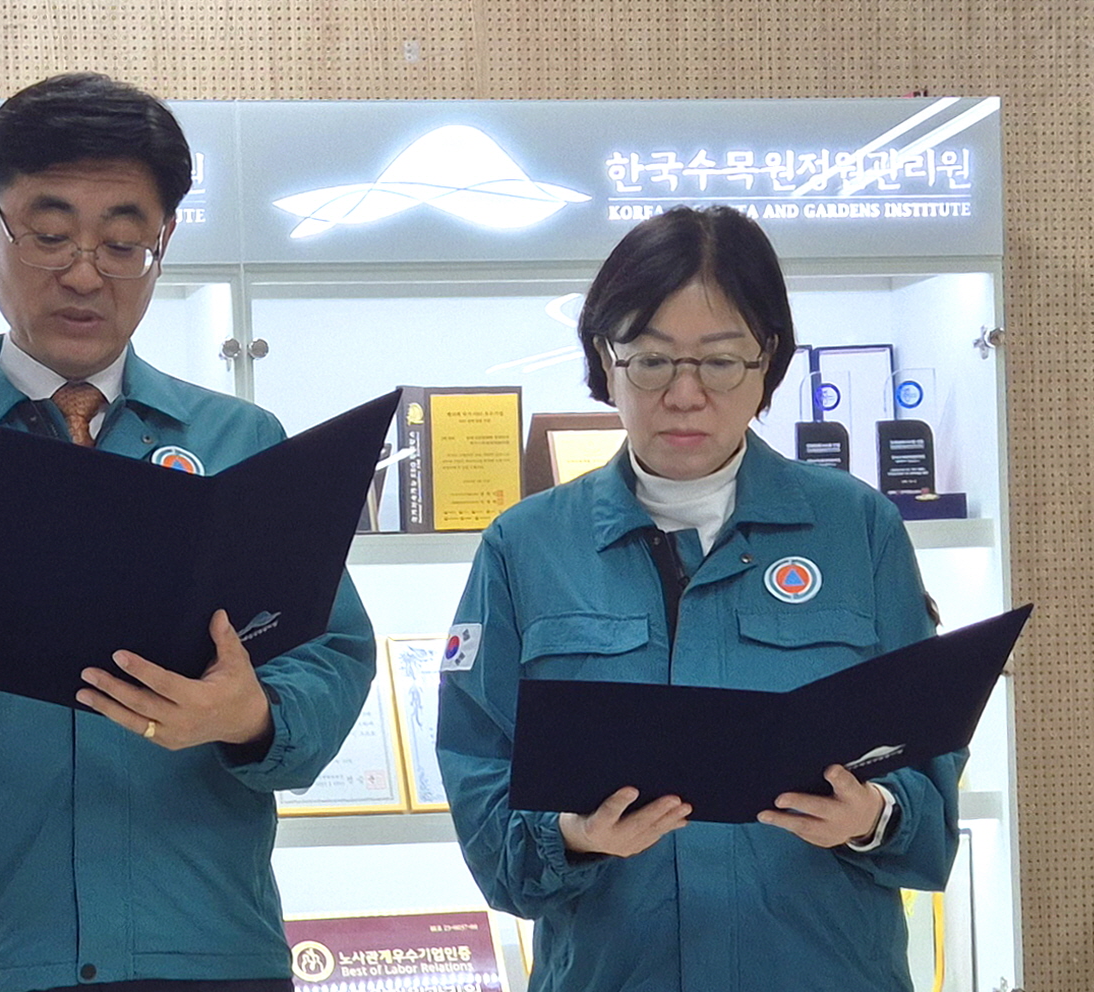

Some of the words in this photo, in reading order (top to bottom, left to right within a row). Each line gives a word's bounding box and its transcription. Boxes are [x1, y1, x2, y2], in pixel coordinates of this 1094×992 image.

[606, 148, 971, 192] 한국수목원정원관리원
[763, 204, 800, 219] AND
[803, 204, 881, 218] GARDENS
[884, 203, 972, 217] INSTITUTE
[341, 967, 367, 977] Best
[369, 965, 382, 975] of
[385, 964, 418, 974] Labor
[421, 962, 474, 973] Relations
